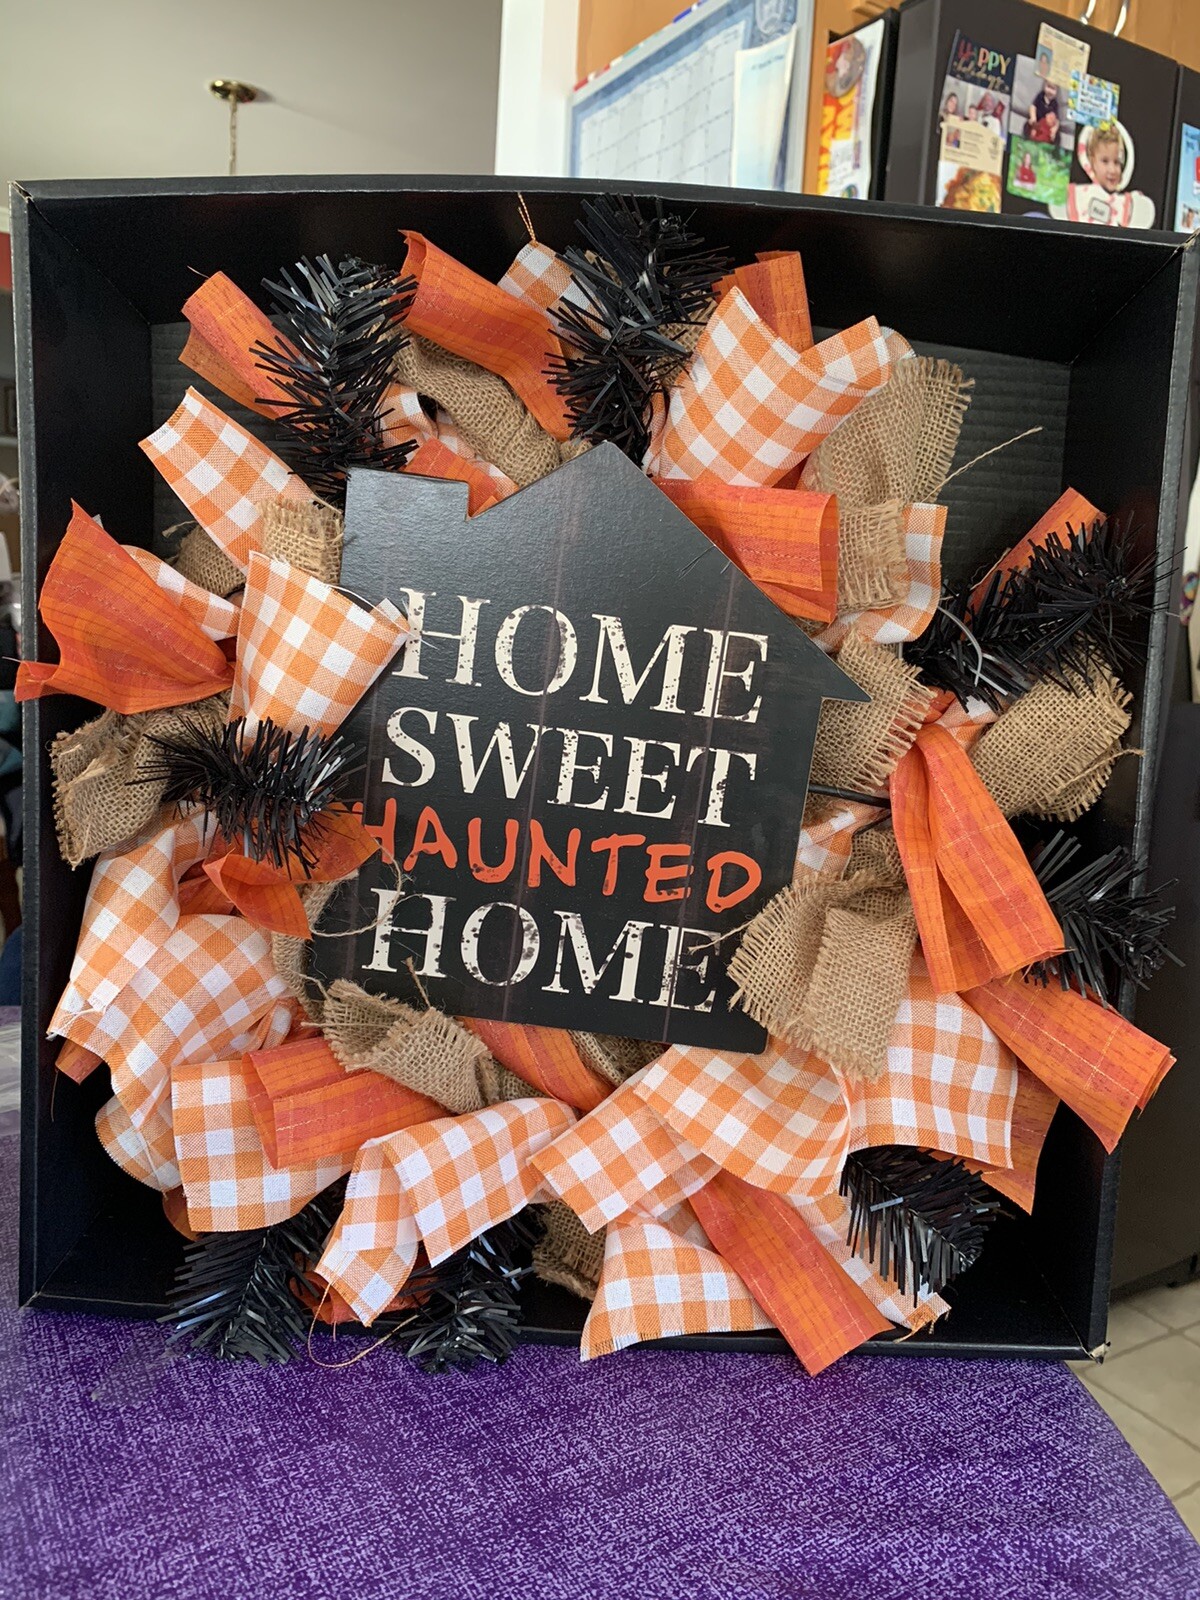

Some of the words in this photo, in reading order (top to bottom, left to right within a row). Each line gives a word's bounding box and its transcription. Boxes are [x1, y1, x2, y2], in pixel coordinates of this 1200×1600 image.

[392, 587, 769, 724] HOME
[381, 706, 758, 828] SWEET
[352, 797, 763, 913] HAUNTED
[361, 887, 722, 1013] HOME
